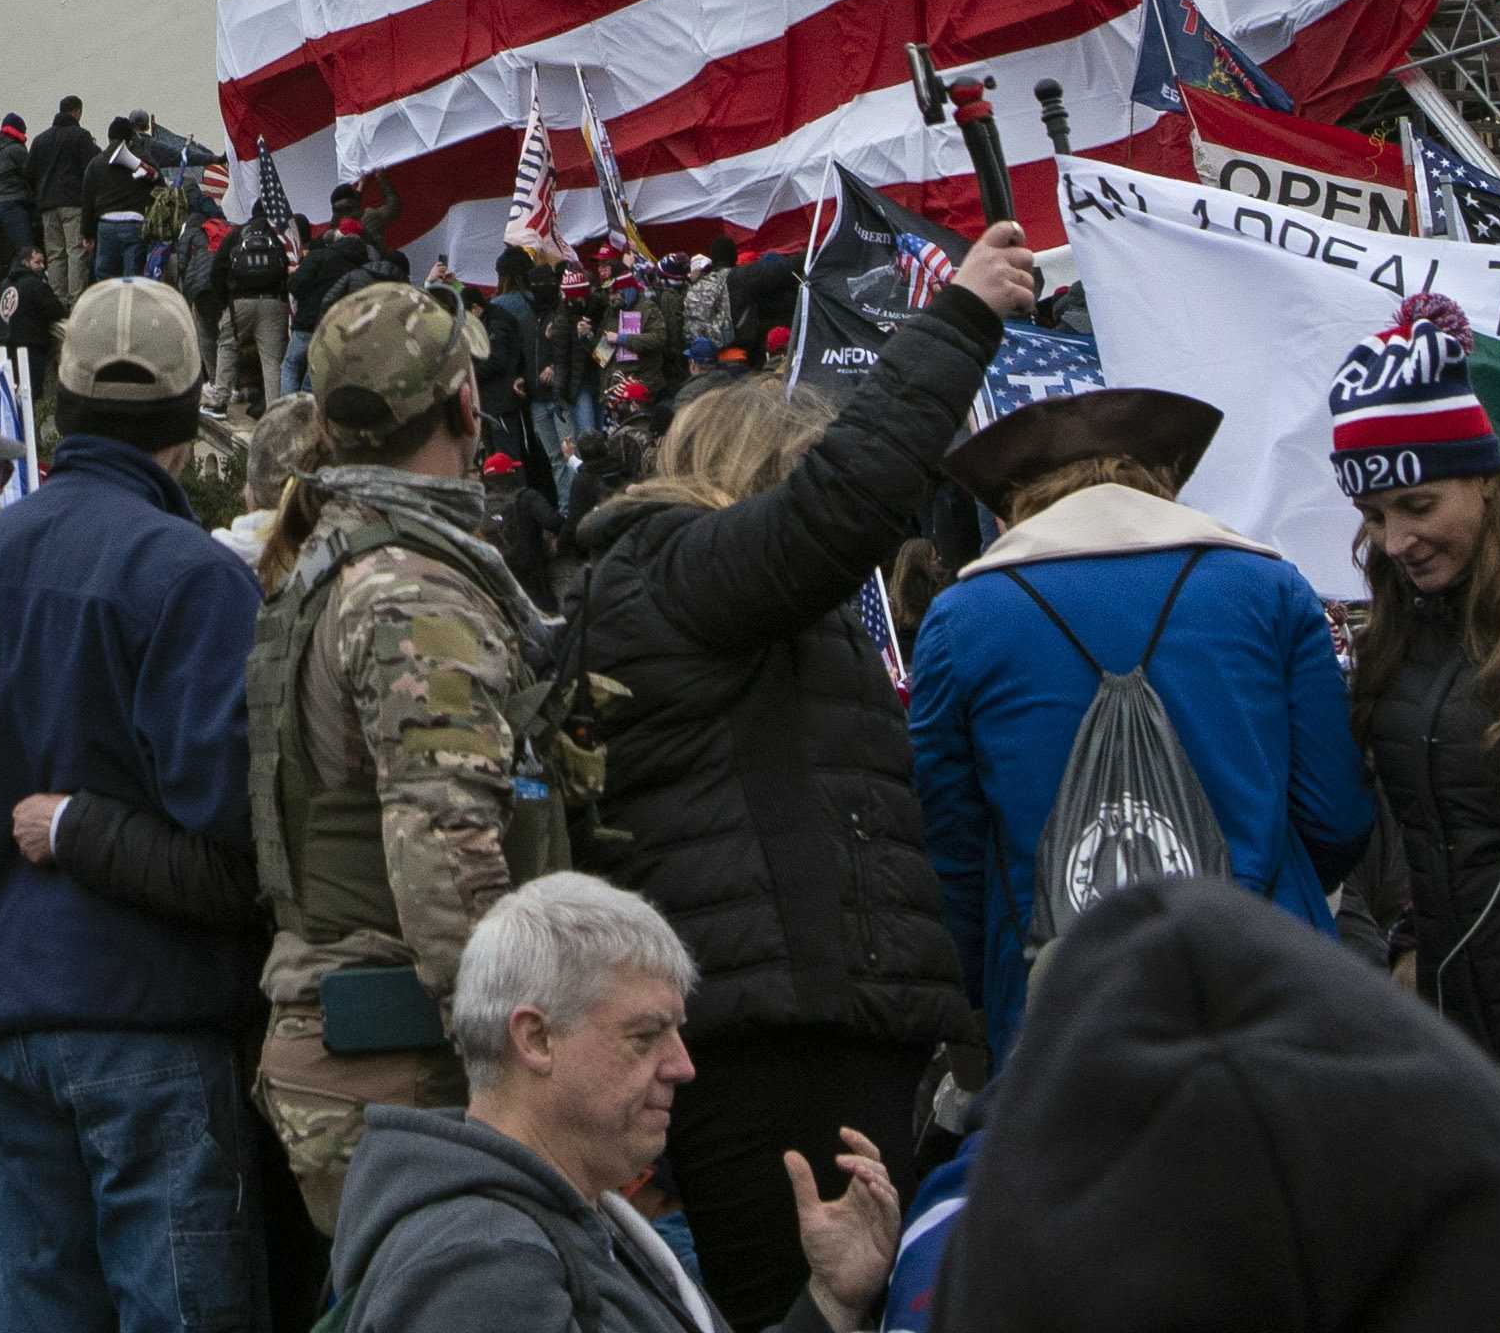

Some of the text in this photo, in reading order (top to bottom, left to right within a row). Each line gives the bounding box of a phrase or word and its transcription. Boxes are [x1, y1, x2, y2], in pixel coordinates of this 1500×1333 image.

[1063, 172, 1149, 223] AN
[1220, 158, 1409, 238] OPEN
[821, 347, 880, 366] INFOW
[1332, 330, 1466, 401] RUMP
